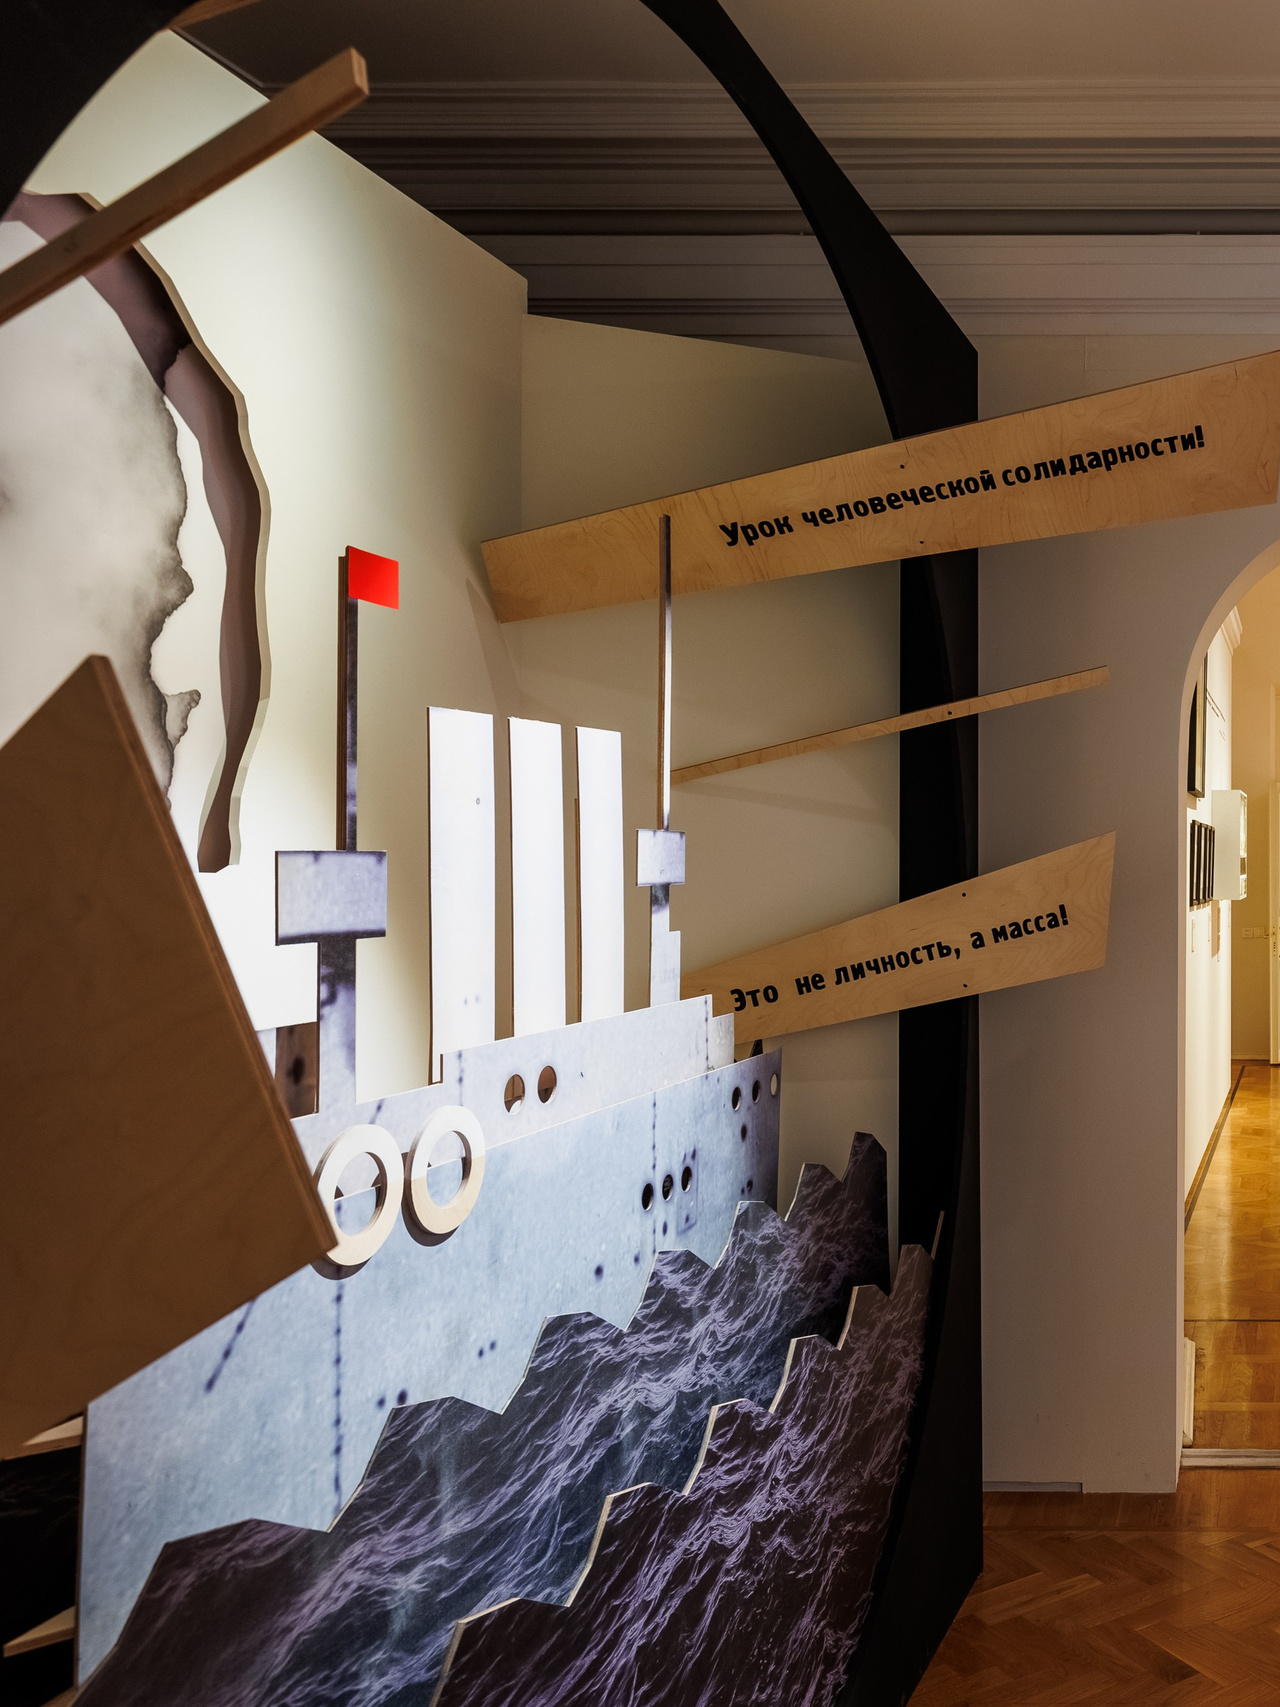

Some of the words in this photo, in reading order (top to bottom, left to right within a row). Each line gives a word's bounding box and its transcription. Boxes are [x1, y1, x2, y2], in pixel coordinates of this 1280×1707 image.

[718, 515, 794, 547] Урок
[801, 469, 997, 528] человеческой
[1001, 425, 1206, 487] солидарности!
[729, 988, 779, 1012] Это
[794, 973, 826, 996] не
[834, 941, 962, 986] личность,
[969, 931, 986, 950] а
[991, 904, 1069, 944] масса!
